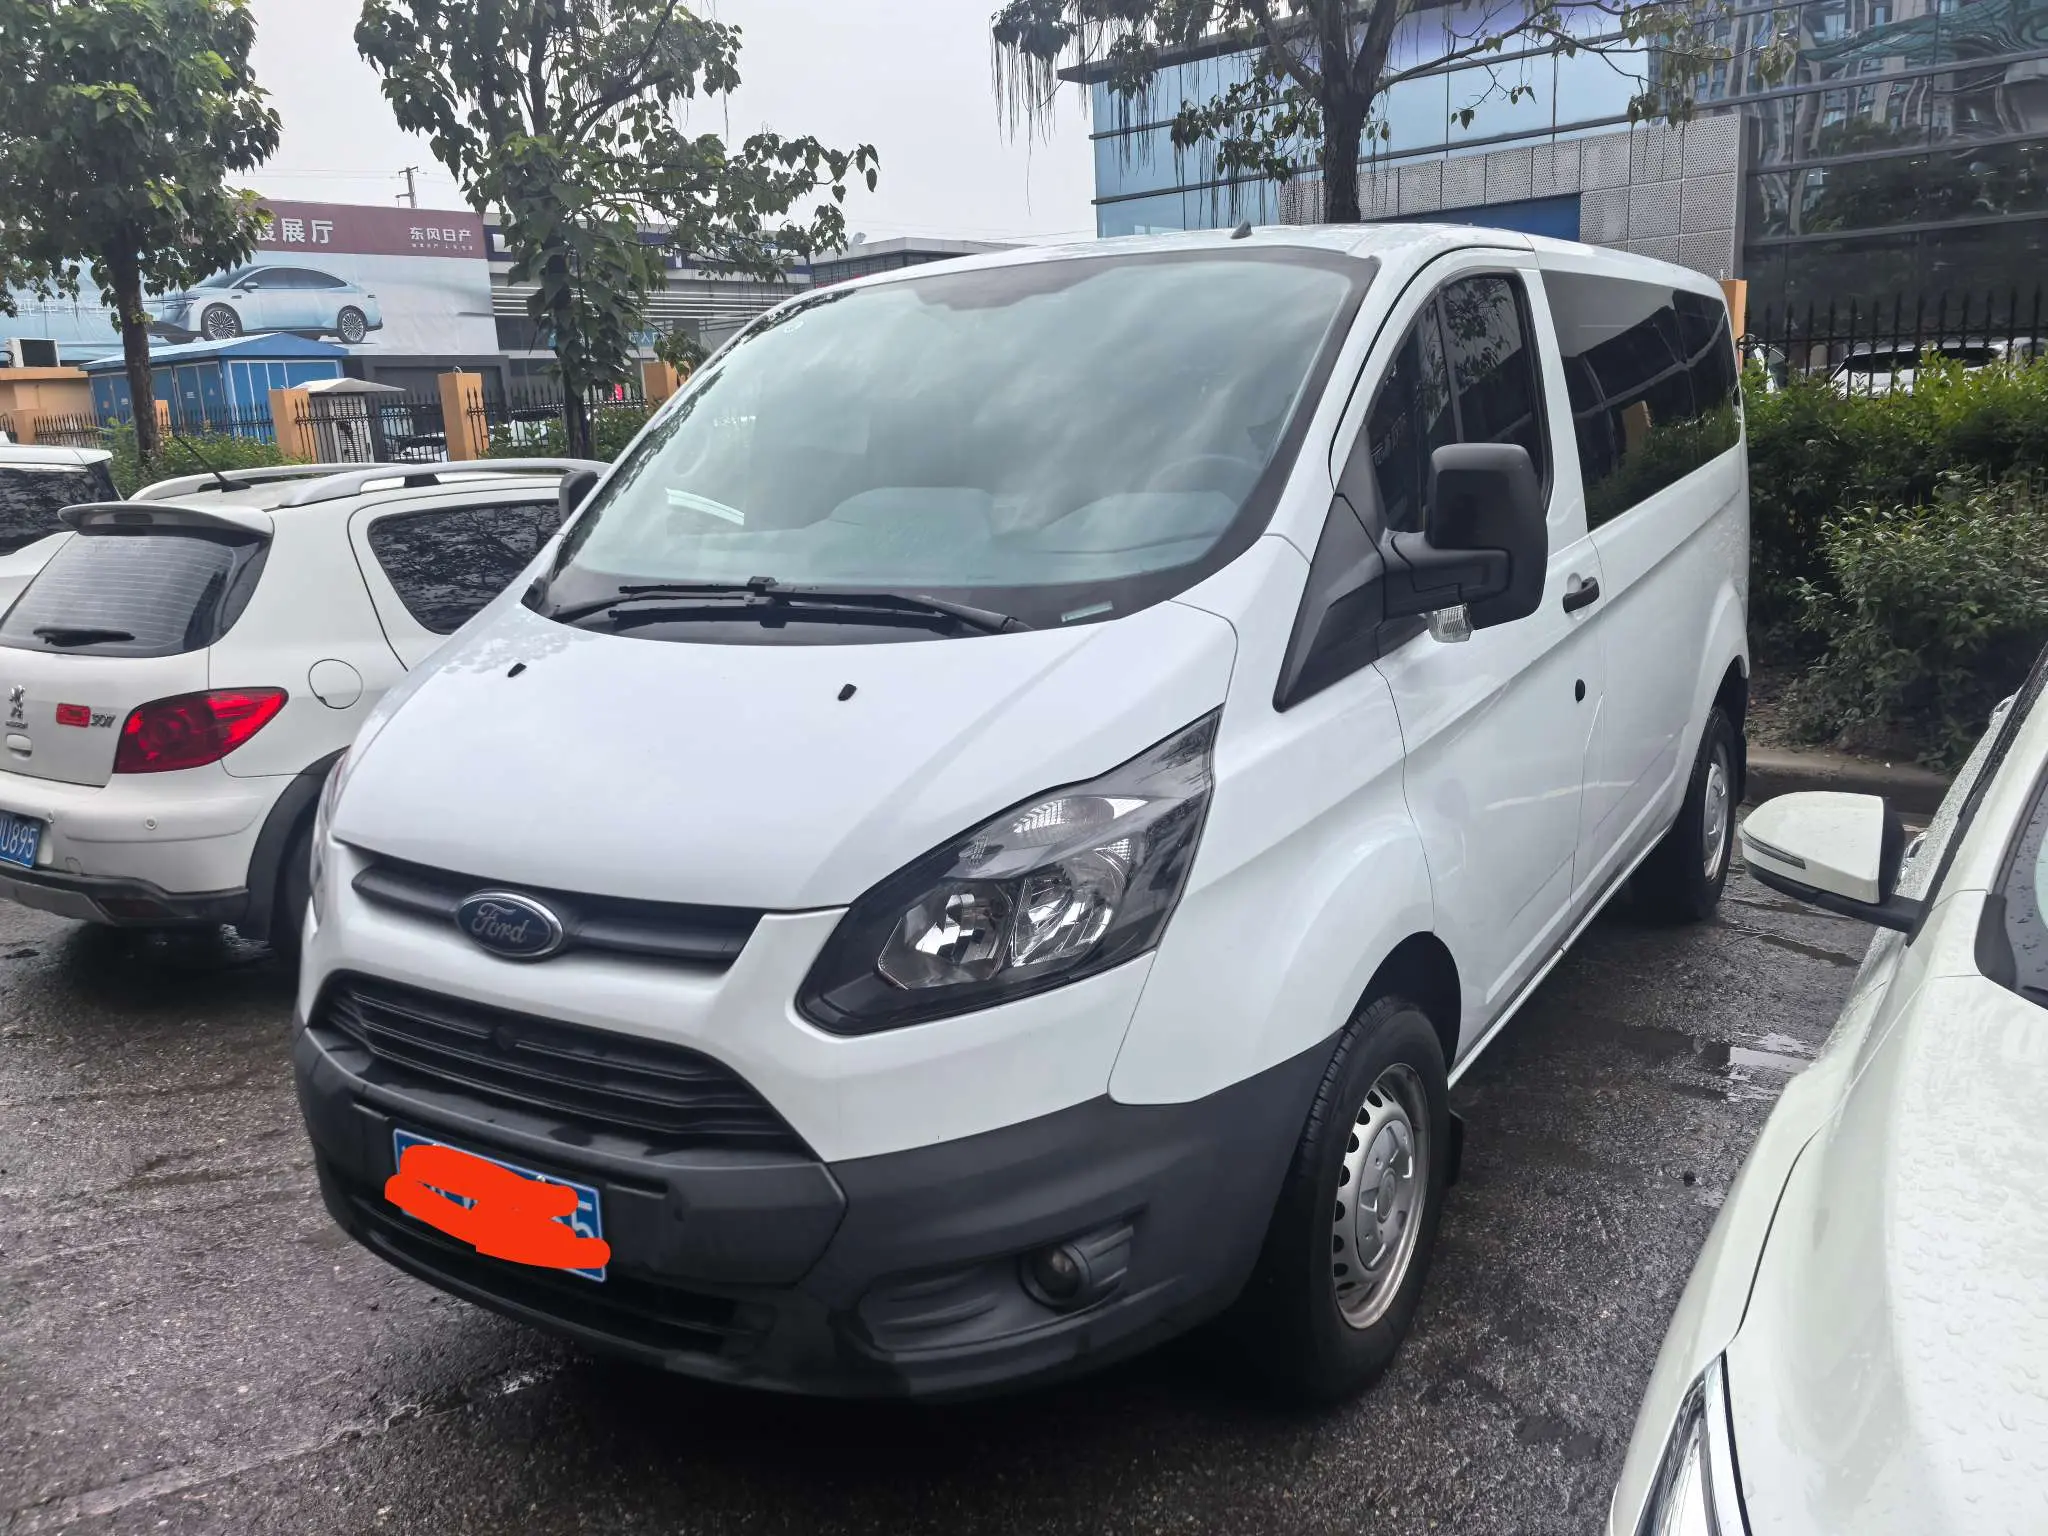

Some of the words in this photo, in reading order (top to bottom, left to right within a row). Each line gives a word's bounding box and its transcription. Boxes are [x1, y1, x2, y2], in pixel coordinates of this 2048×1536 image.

[409, 226, 472, 242] 东风日产
[0, 817, 38, 859] U895
[471, 902, 530, 944] Ford
